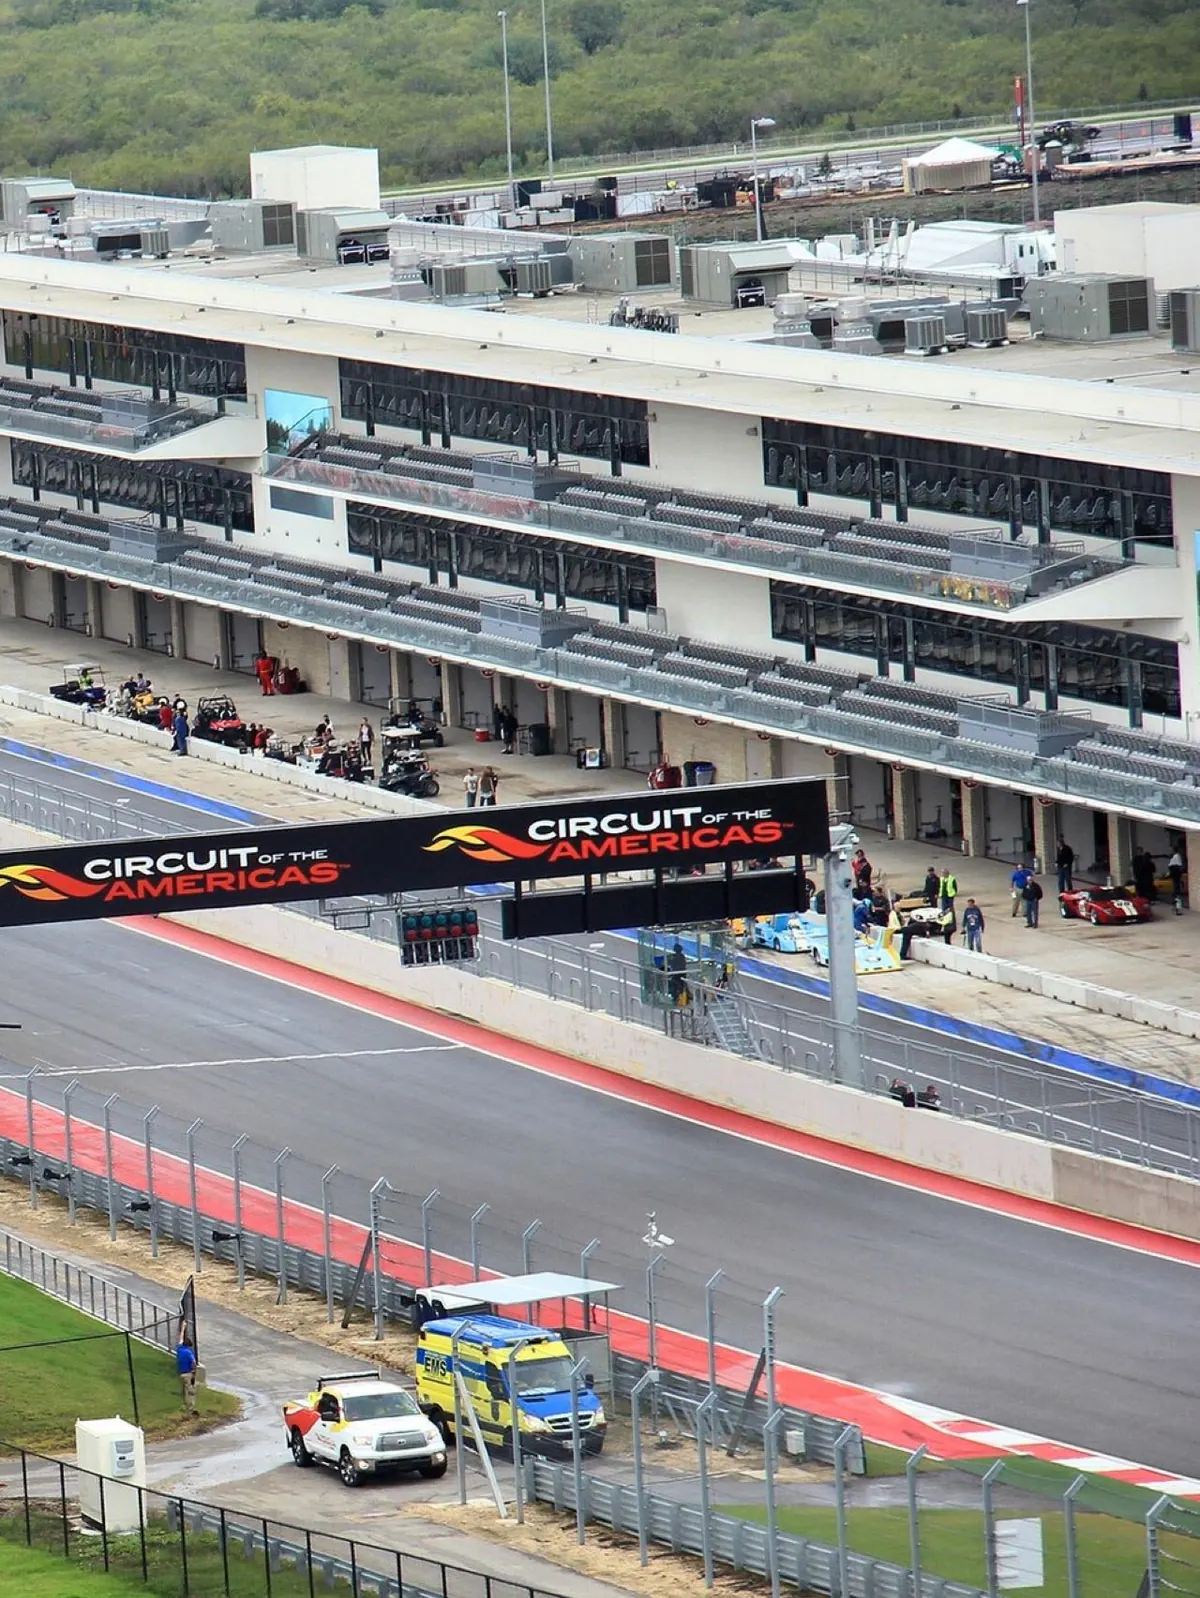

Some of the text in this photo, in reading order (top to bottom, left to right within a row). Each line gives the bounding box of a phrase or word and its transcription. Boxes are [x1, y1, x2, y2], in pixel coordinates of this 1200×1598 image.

[527, 806, 772, 841] CIRCUIT OF THE
[548, 821, 783, 863] AMERICAS
[83, 846, 328, 880] CIRCUIT OF THE
[103, 862, 339, 901] AMERICAS
[424, 1356, 447, 1377] EMS
